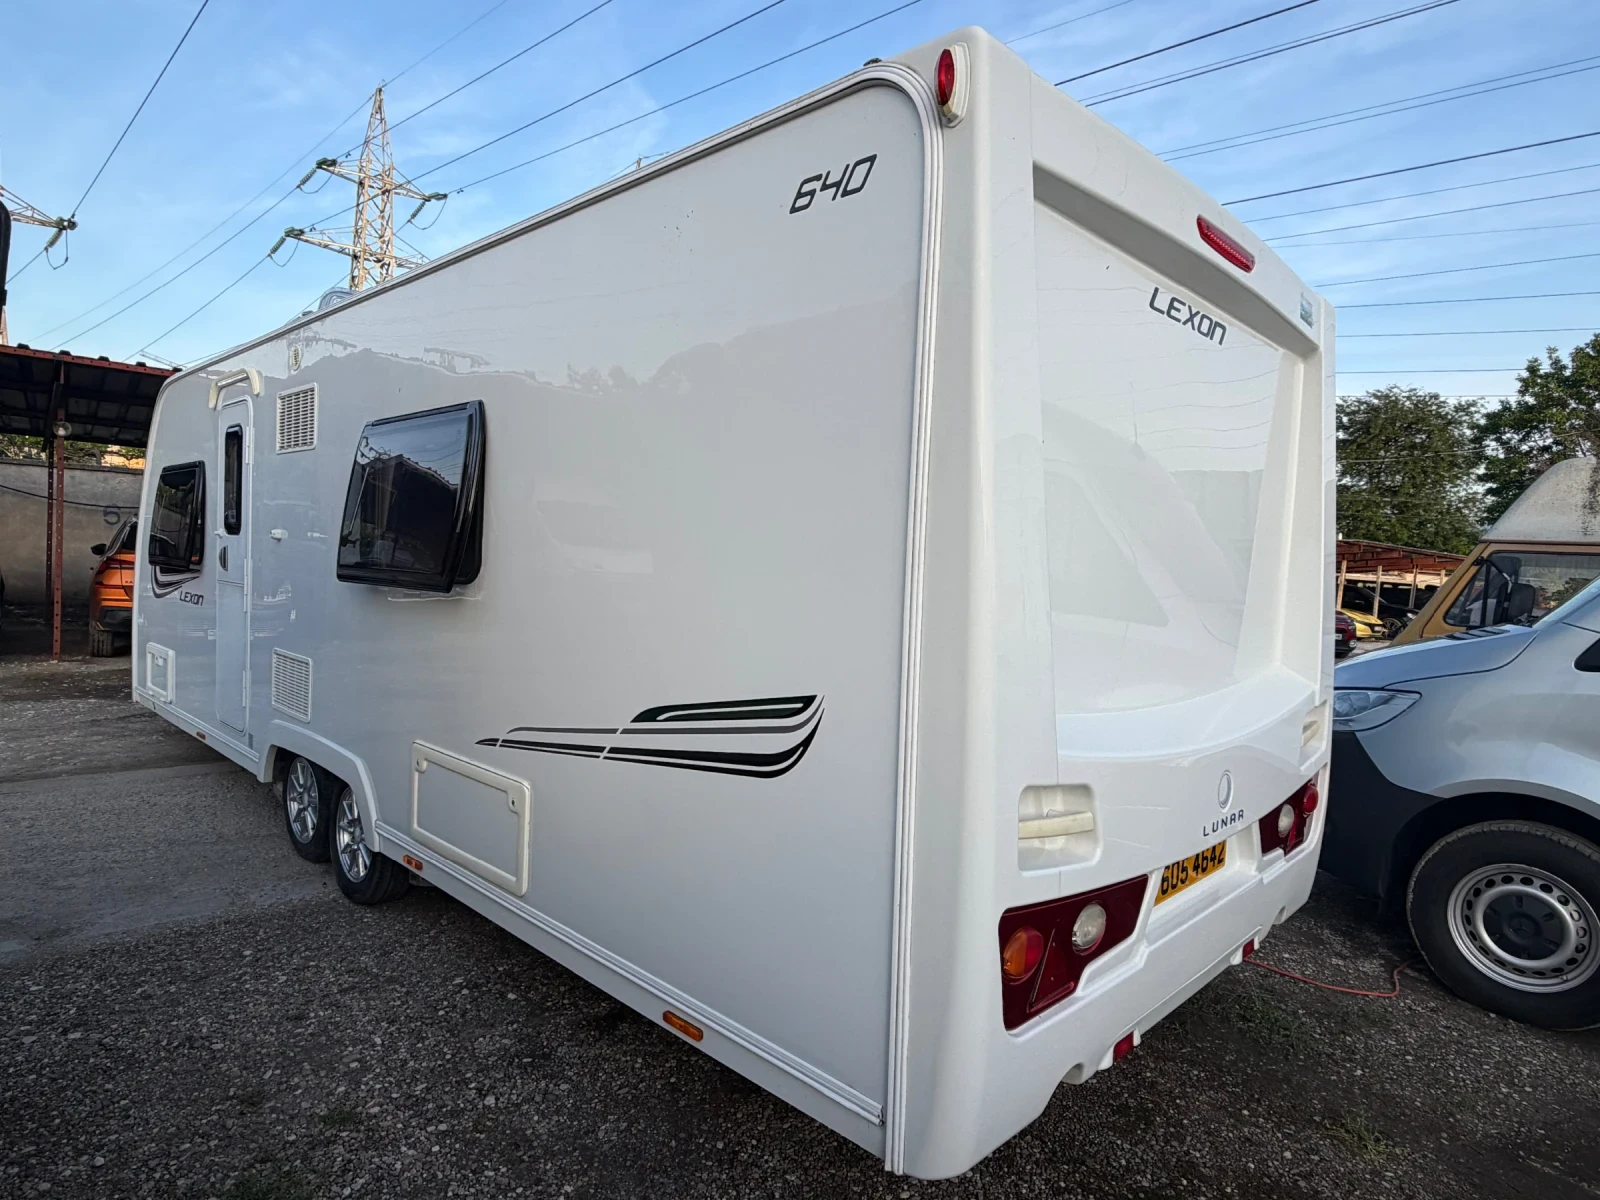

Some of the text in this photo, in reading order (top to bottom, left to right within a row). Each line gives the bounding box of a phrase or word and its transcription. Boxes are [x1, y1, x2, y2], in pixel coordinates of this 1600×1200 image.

[789, 153, 878, 215] 640
[1149, 286, 1227, 346] LEXON
[179, 590, 204, 606] LEXON
[1202, 808, 1245, 837] LUNAR
[1160, 860, 1189, 896] 605
